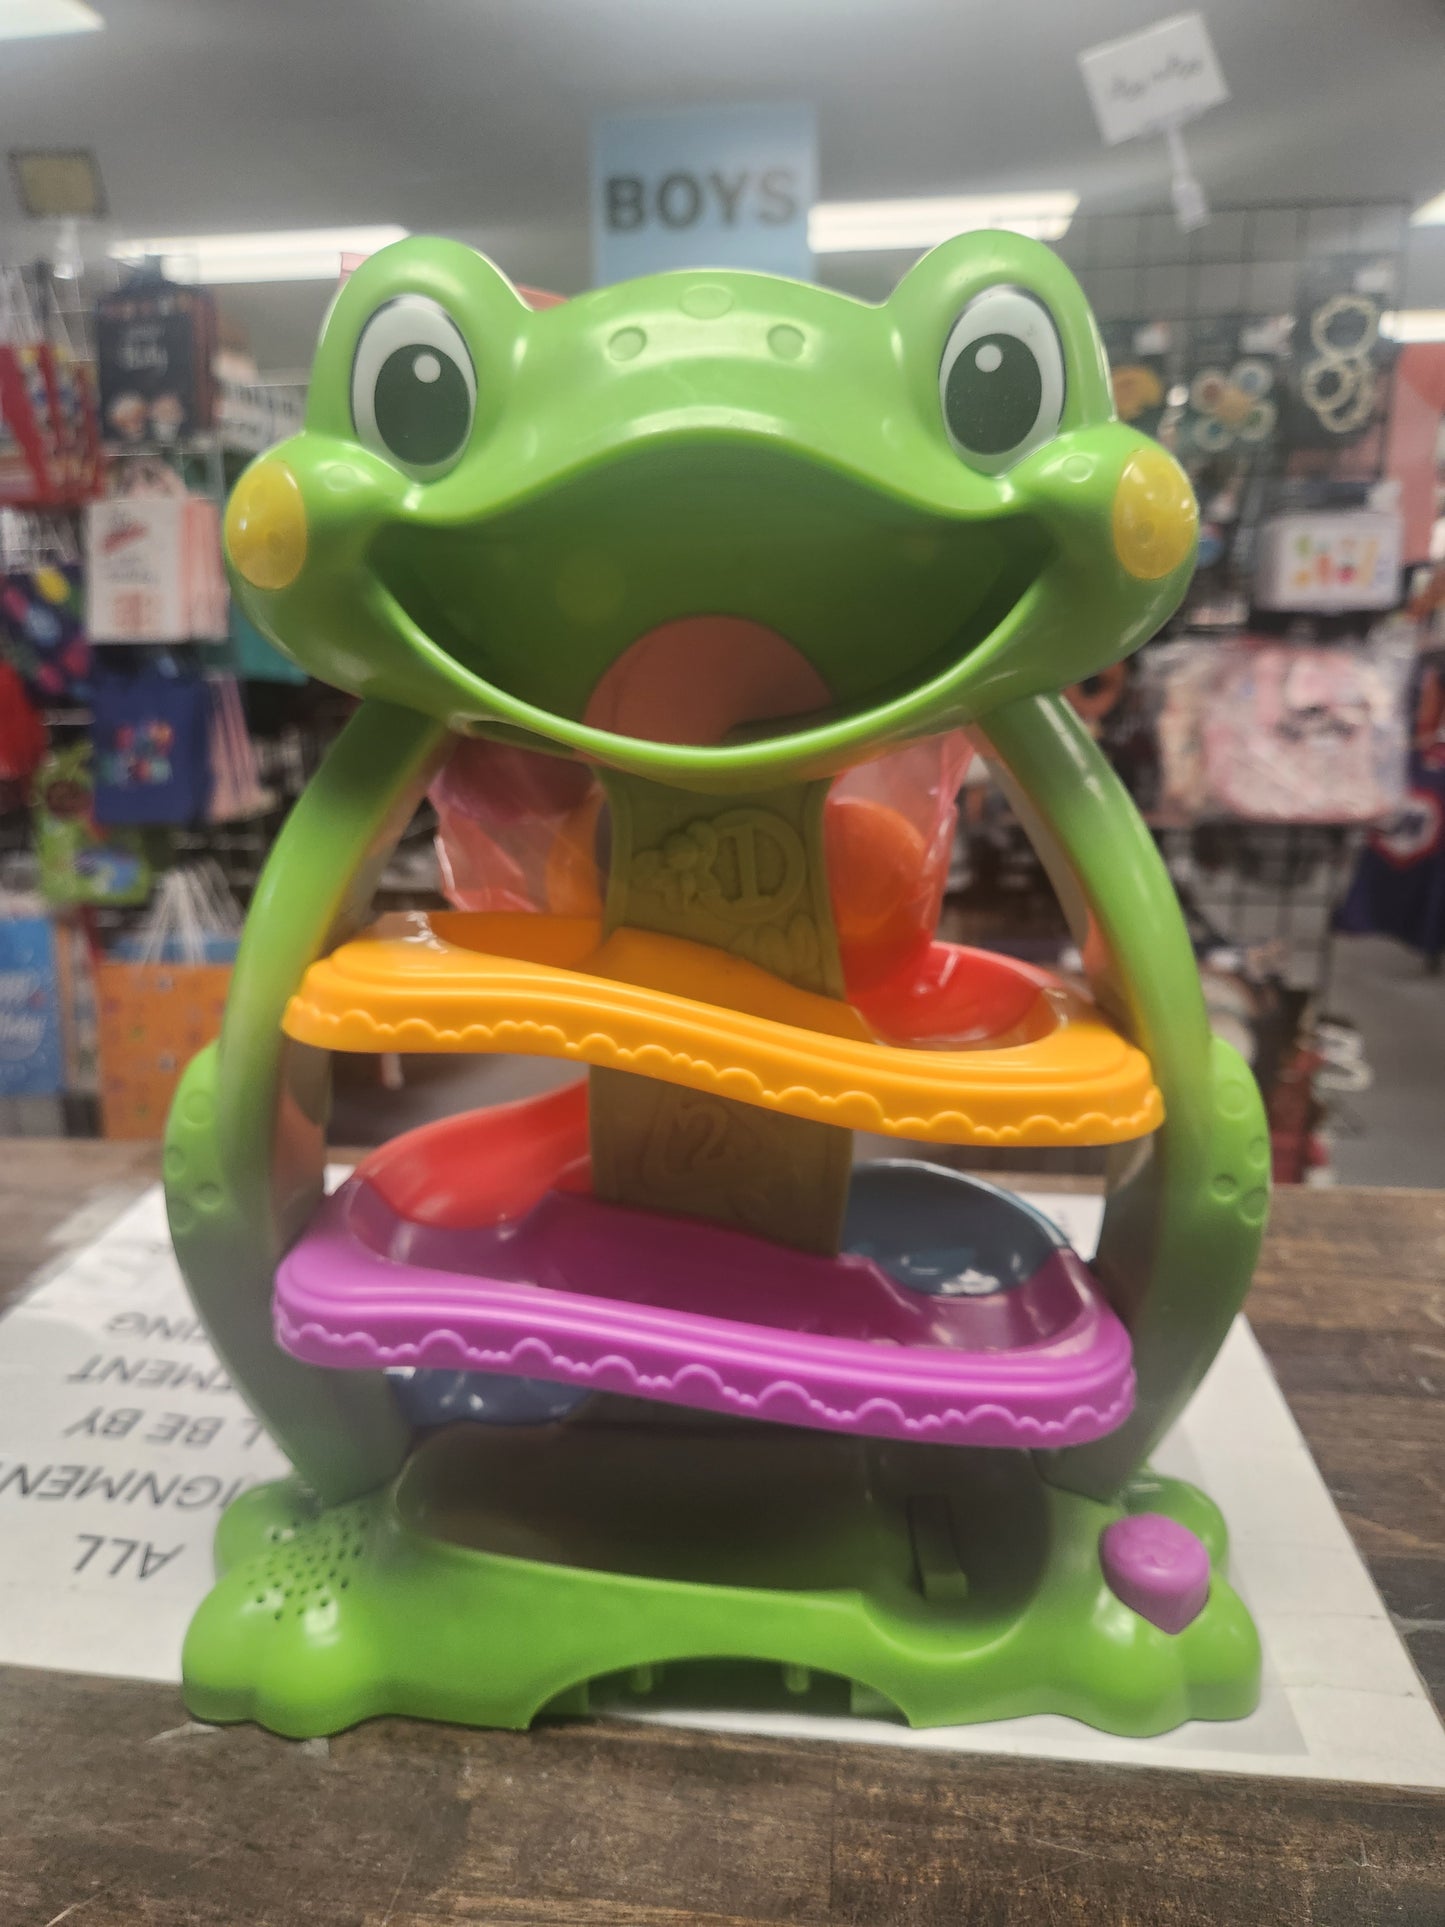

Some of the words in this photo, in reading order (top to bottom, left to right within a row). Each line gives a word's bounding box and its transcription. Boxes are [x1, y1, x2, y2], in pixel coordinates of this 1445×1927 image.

[603, 168, 799, 232] BOYS
[62, 1406, 145, 1439] BY
[145, 1412, 226, 1447] BE
[0, 1462, 243, 1511] IGNMEN
[73, 1533, 186, 1580] ALL
